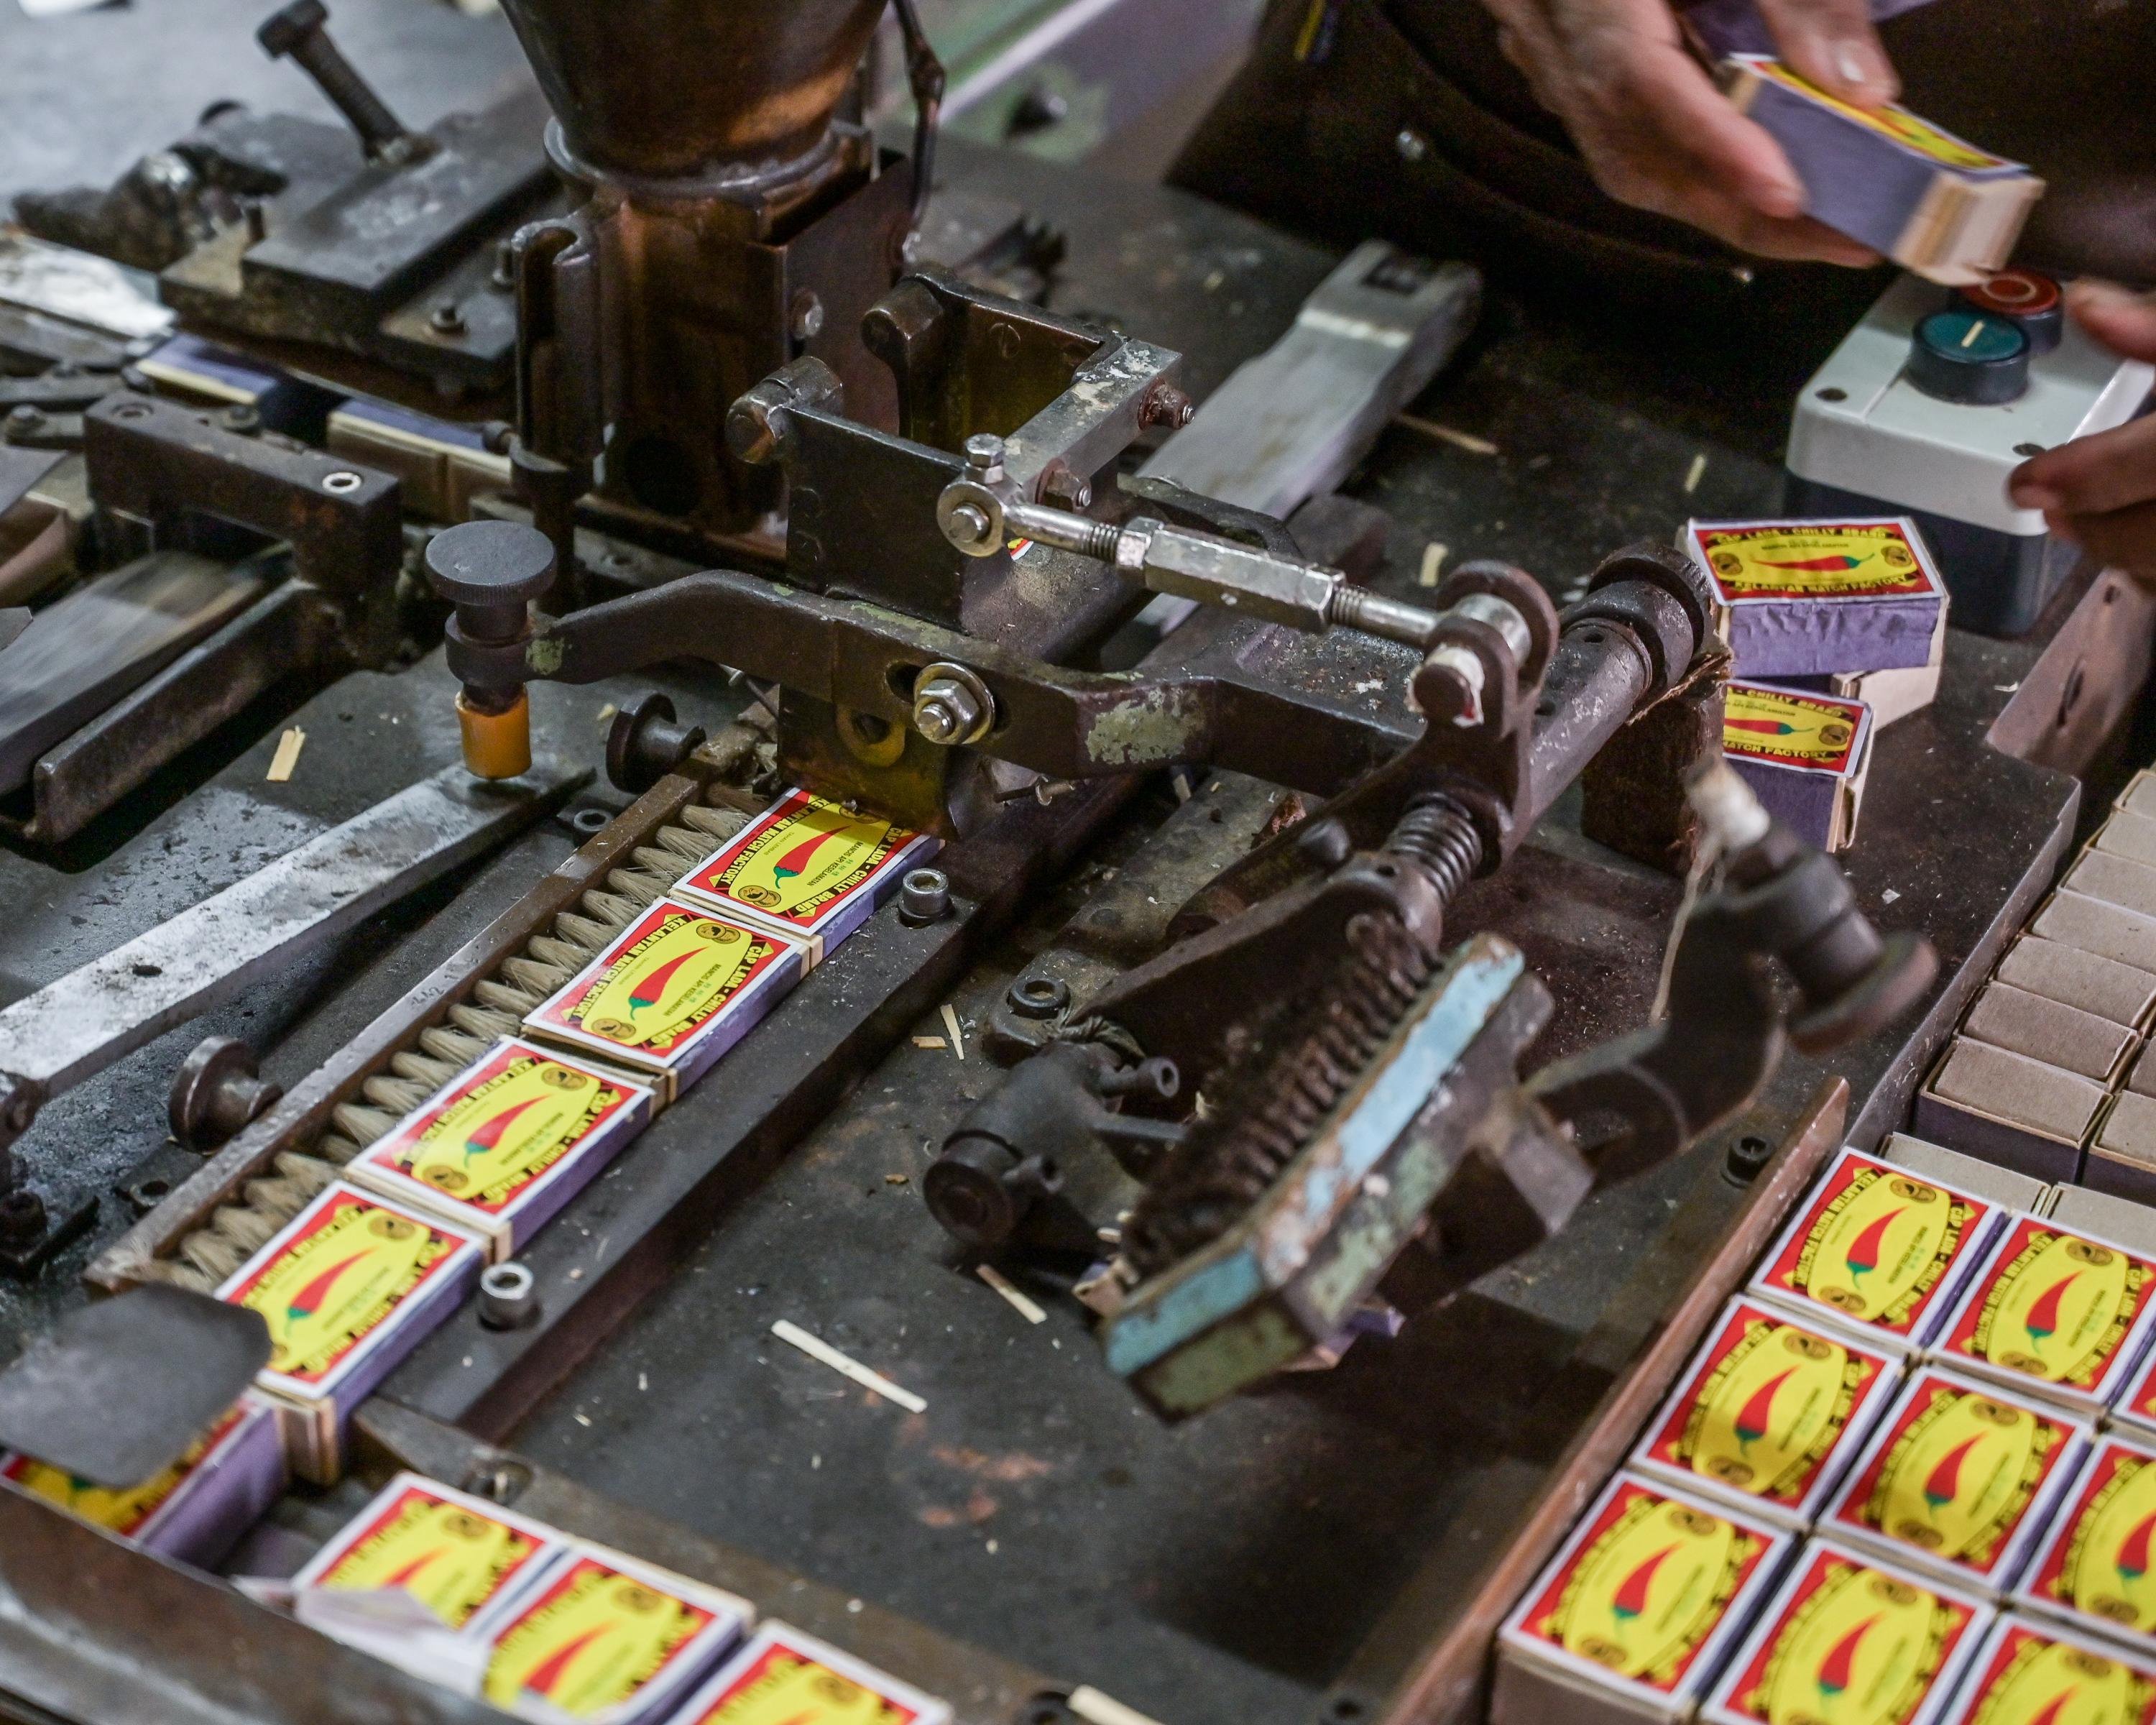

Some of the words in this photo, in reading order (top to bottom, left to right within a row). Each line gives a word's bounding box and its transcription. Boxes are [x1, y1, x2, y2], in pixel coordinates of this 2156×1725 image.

[1764, 746, 1828, 758] FACTORY
[771, 797, 831, 829] KELANTAN
[746, 827, 780, 852] MATCH
[882, 826, 903, 842] CAP
[864, 843, 890, 865] LADA
[720, 850, 755, 884] FACTORY
[830, 869, 869, 893] CHILLY
[792, 891, 837, 912] BRAND
[626, 917, 688, 956] KELANTAN
[741, 944, 763, 964] CAP
[598, 954, 635, 983] MATCH
[723, 964, 751, 989] LADA
[570, 980, 608, 1018] FACTORY
[686, 992, 729, 1022] CHILLY
[647, 1020, 695, 1044] BRAND
